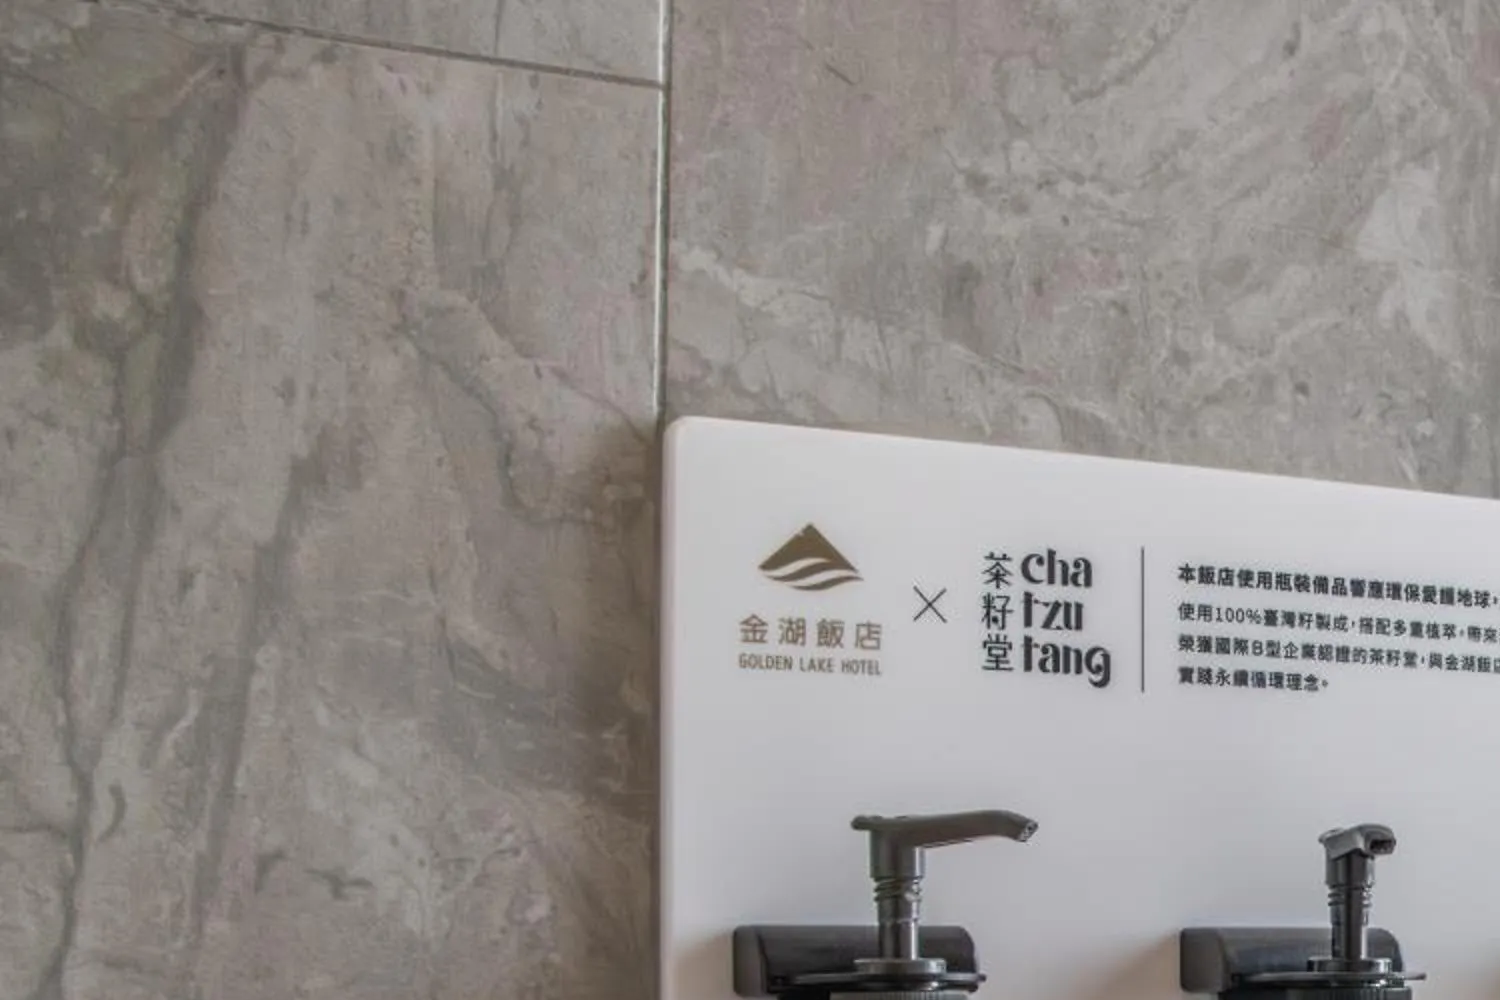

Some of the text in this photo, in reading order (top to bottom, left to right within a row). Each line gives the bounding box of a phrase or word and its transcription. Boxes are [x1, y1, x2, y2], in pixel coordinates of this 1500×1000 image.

[1021, 548, 1093, 588] cha
[981, 551, 1014, 672] 茶籽堂
[1021, 591, 1084, 631] tzu
[739, 614, 882, 651] 金湖飯店
[739, 653, 882, 676] GOLDEN LAKE HOTEL
[1021, 634, 1111, 689] tang
